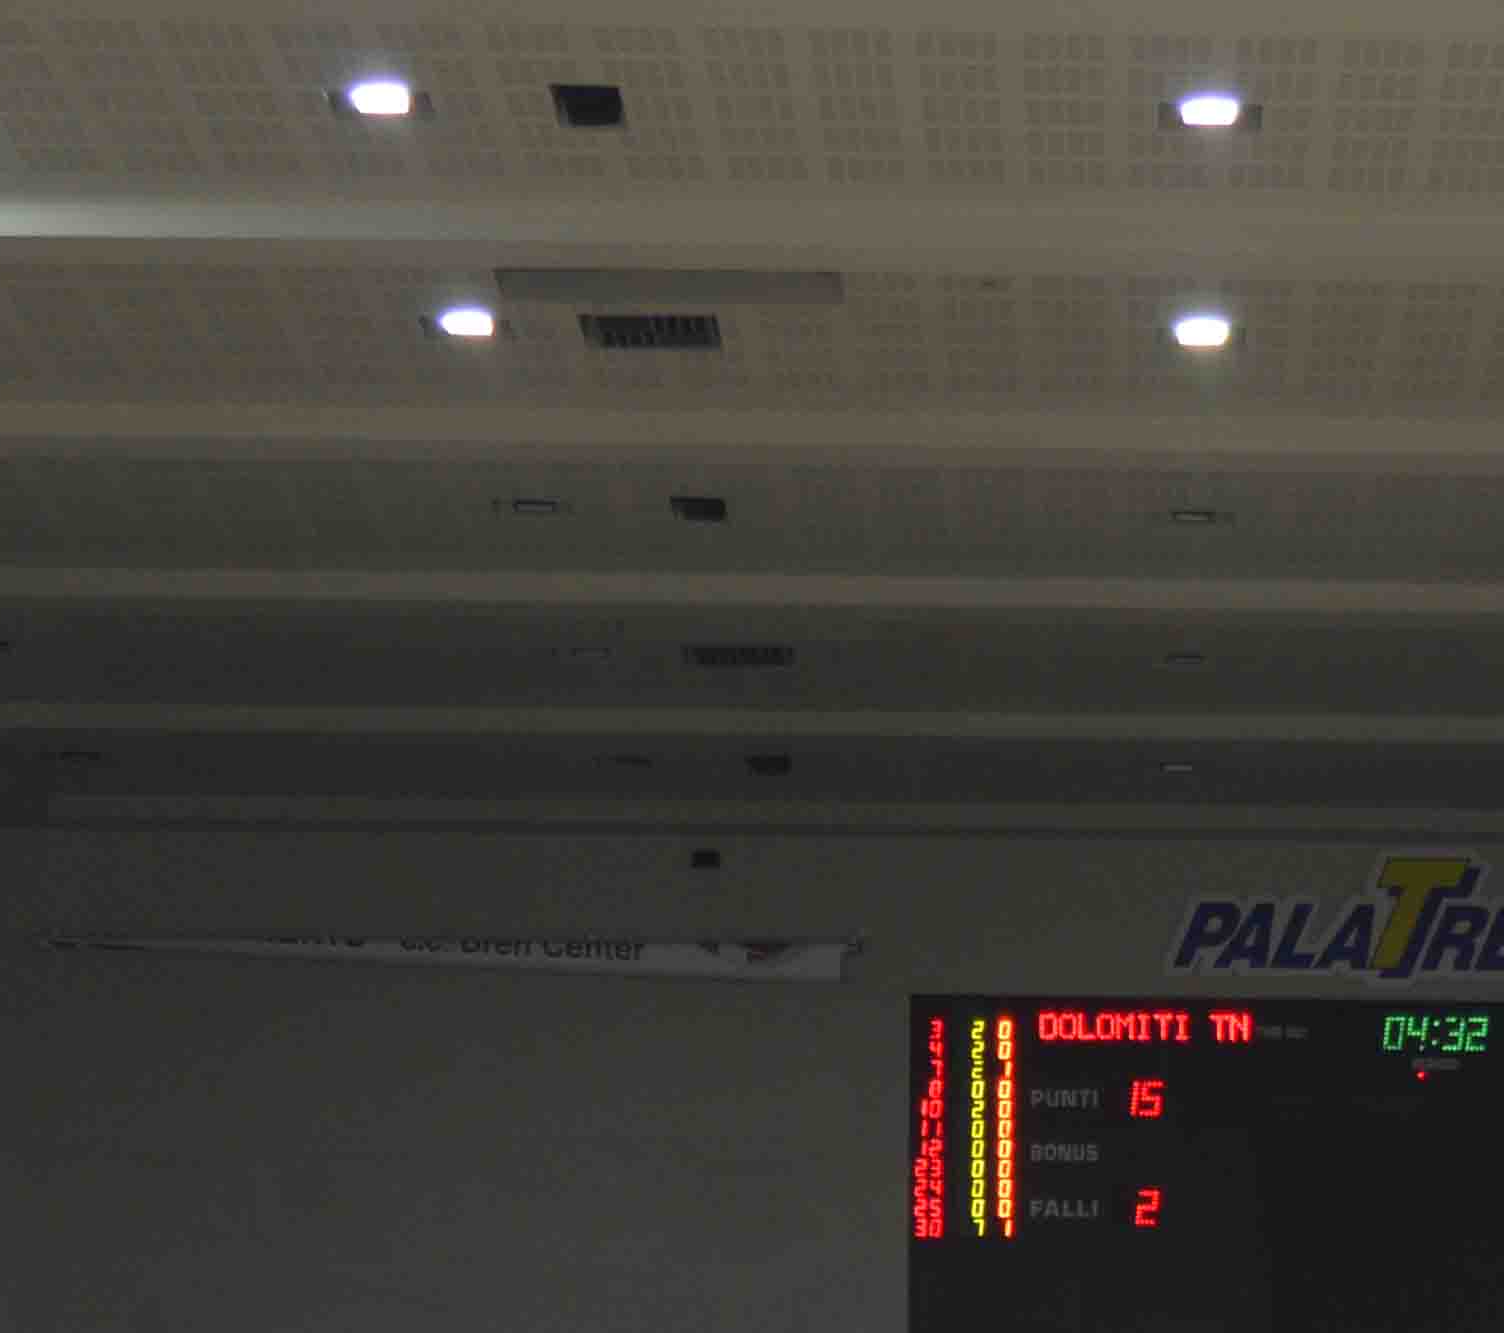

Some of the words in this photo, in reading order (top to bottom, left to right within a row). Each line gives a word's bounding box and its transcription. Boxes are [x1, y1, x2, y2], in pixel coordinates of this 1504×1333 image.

[971, 1020, 985, 1039] 2
[1038, 1011, 1191, 1041] DOLOMITI
[1208, 1011, 1253, 1042] TN
[1382, 1015, 1489, 1053] 04:32
[971, 1041, 985, 1059] 2
[1030, 1089, 1100, 1109] PUNTI
[1130, 1080, 1164, 1118] 15
[971, 1100, 985, 1118] 2
[1030, 1143, 1099, 1161] BONUS
[1030, 1199, 1100, 1218] FALLI
[1134, 1187, 1162, 1227] 2
[971, 1219, 985, 1238] 7
